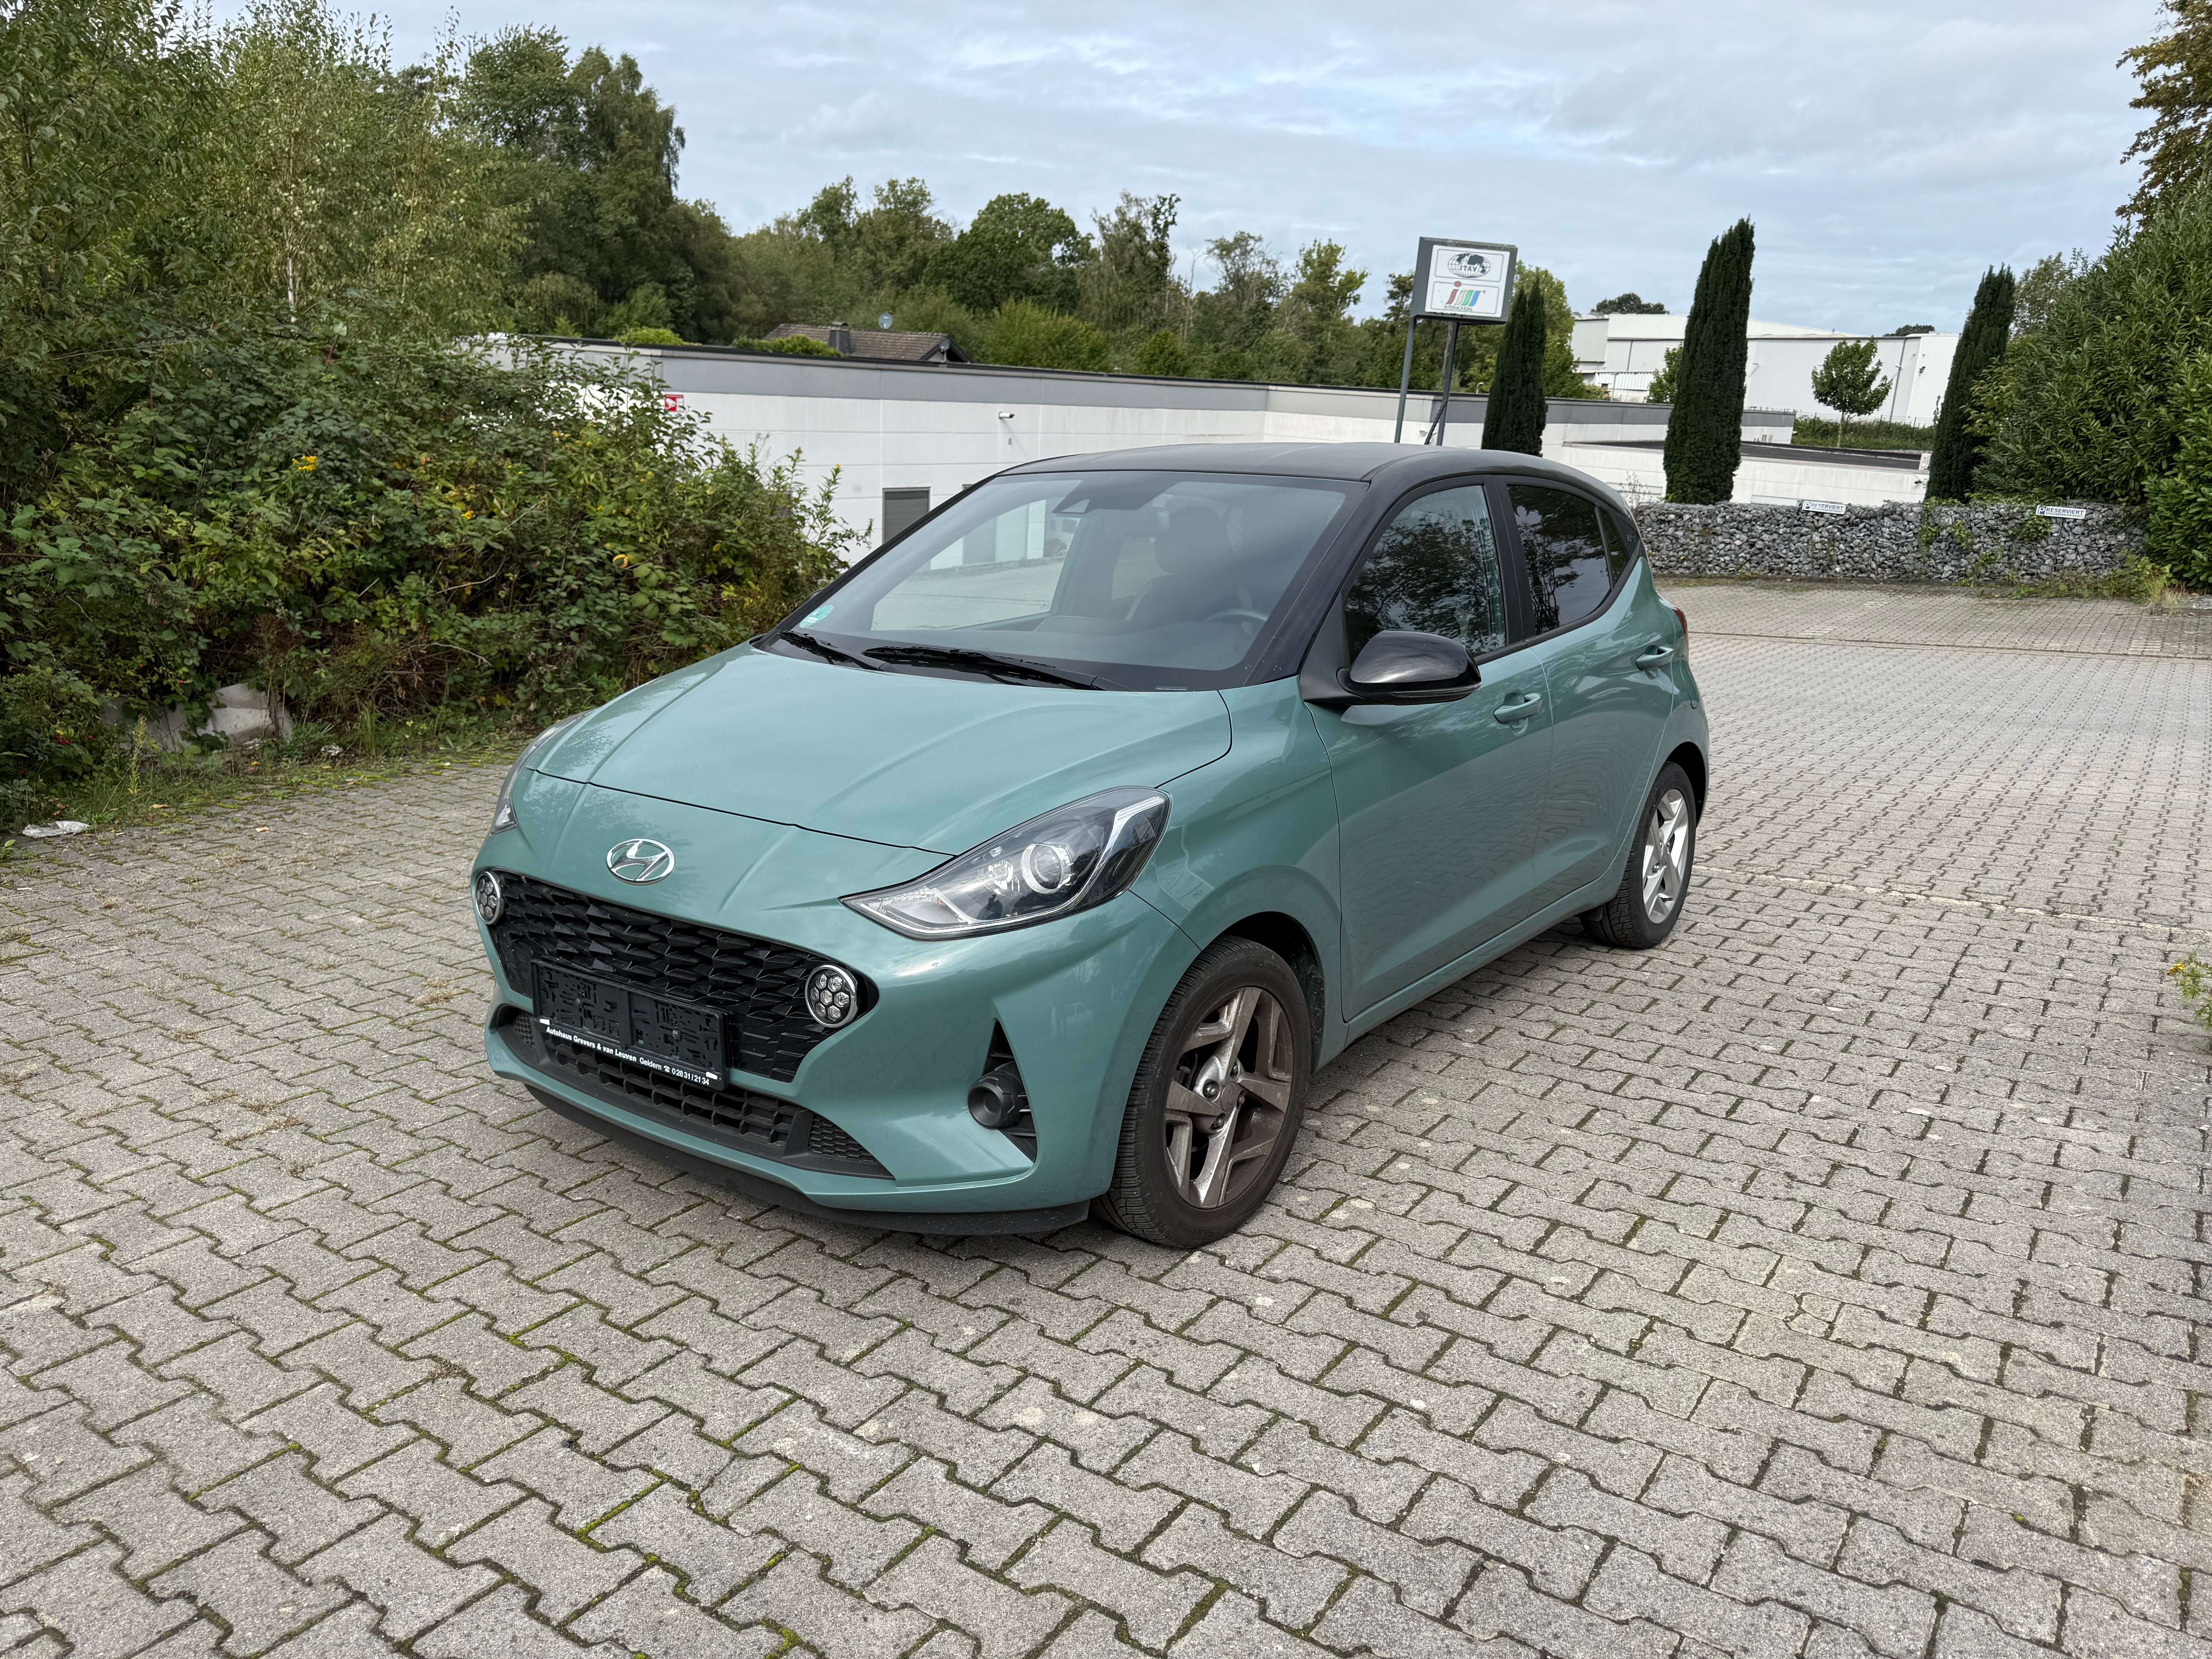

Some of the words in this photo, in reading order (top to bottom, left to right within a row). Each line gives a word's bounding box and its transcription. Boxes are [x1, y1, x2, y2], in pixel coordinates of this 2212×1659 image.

[546, 1026, 572, 1041] Autohaus
[574, 1035, 596, 1048] Grevers
[603, 1046, 613, 1054] van
[615, 1048, 637, 1062] Leuven
[640, 1057, 662, 1070] Geldern
